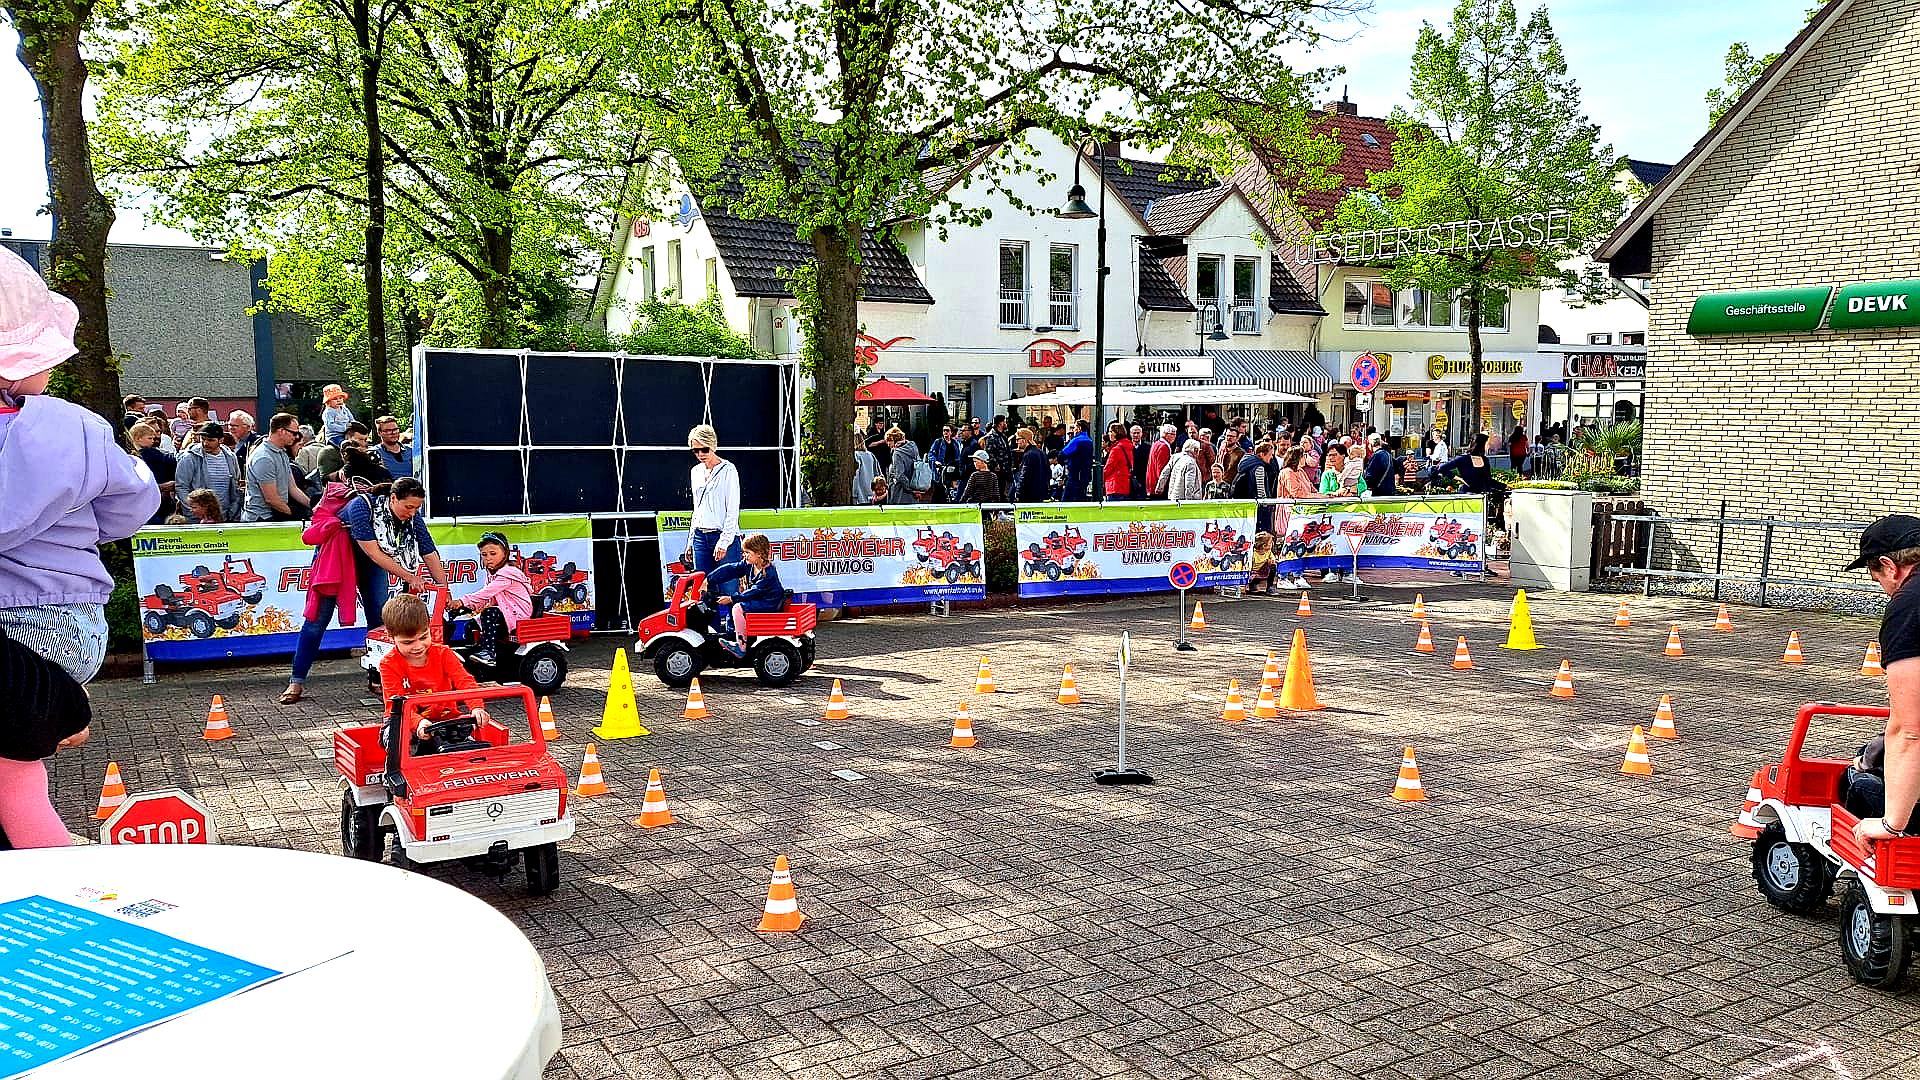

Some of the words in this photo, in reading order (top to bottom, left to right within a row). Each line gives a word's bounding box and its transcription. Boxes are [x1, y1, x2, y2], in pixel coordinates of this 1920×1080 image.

[1725, 303, 1806, 316] Geschäftsstelle
[1847, 294, 1909, 313] DEVK
[854, 345, 879, 366] BS
[1029, 349, 1066, 368] LBS
[1147, 362, 1181, 373] VELTINS
[662, 517, 680, 527] JM
[132, 538, 157, 551] JM
[203, 541, 229, 549] GmbH
[769, 537, 905, 561] FEUERWEHR
[1093, 530, 1196, 552] FEUERWEHR
[1122, 551, 1172, 564] UNIMOG
[807, 559, 875, 576] UNIMOG
[443, 769, 541, 789] FEUERWEHR
[117, 818, 200, 845] STOP
